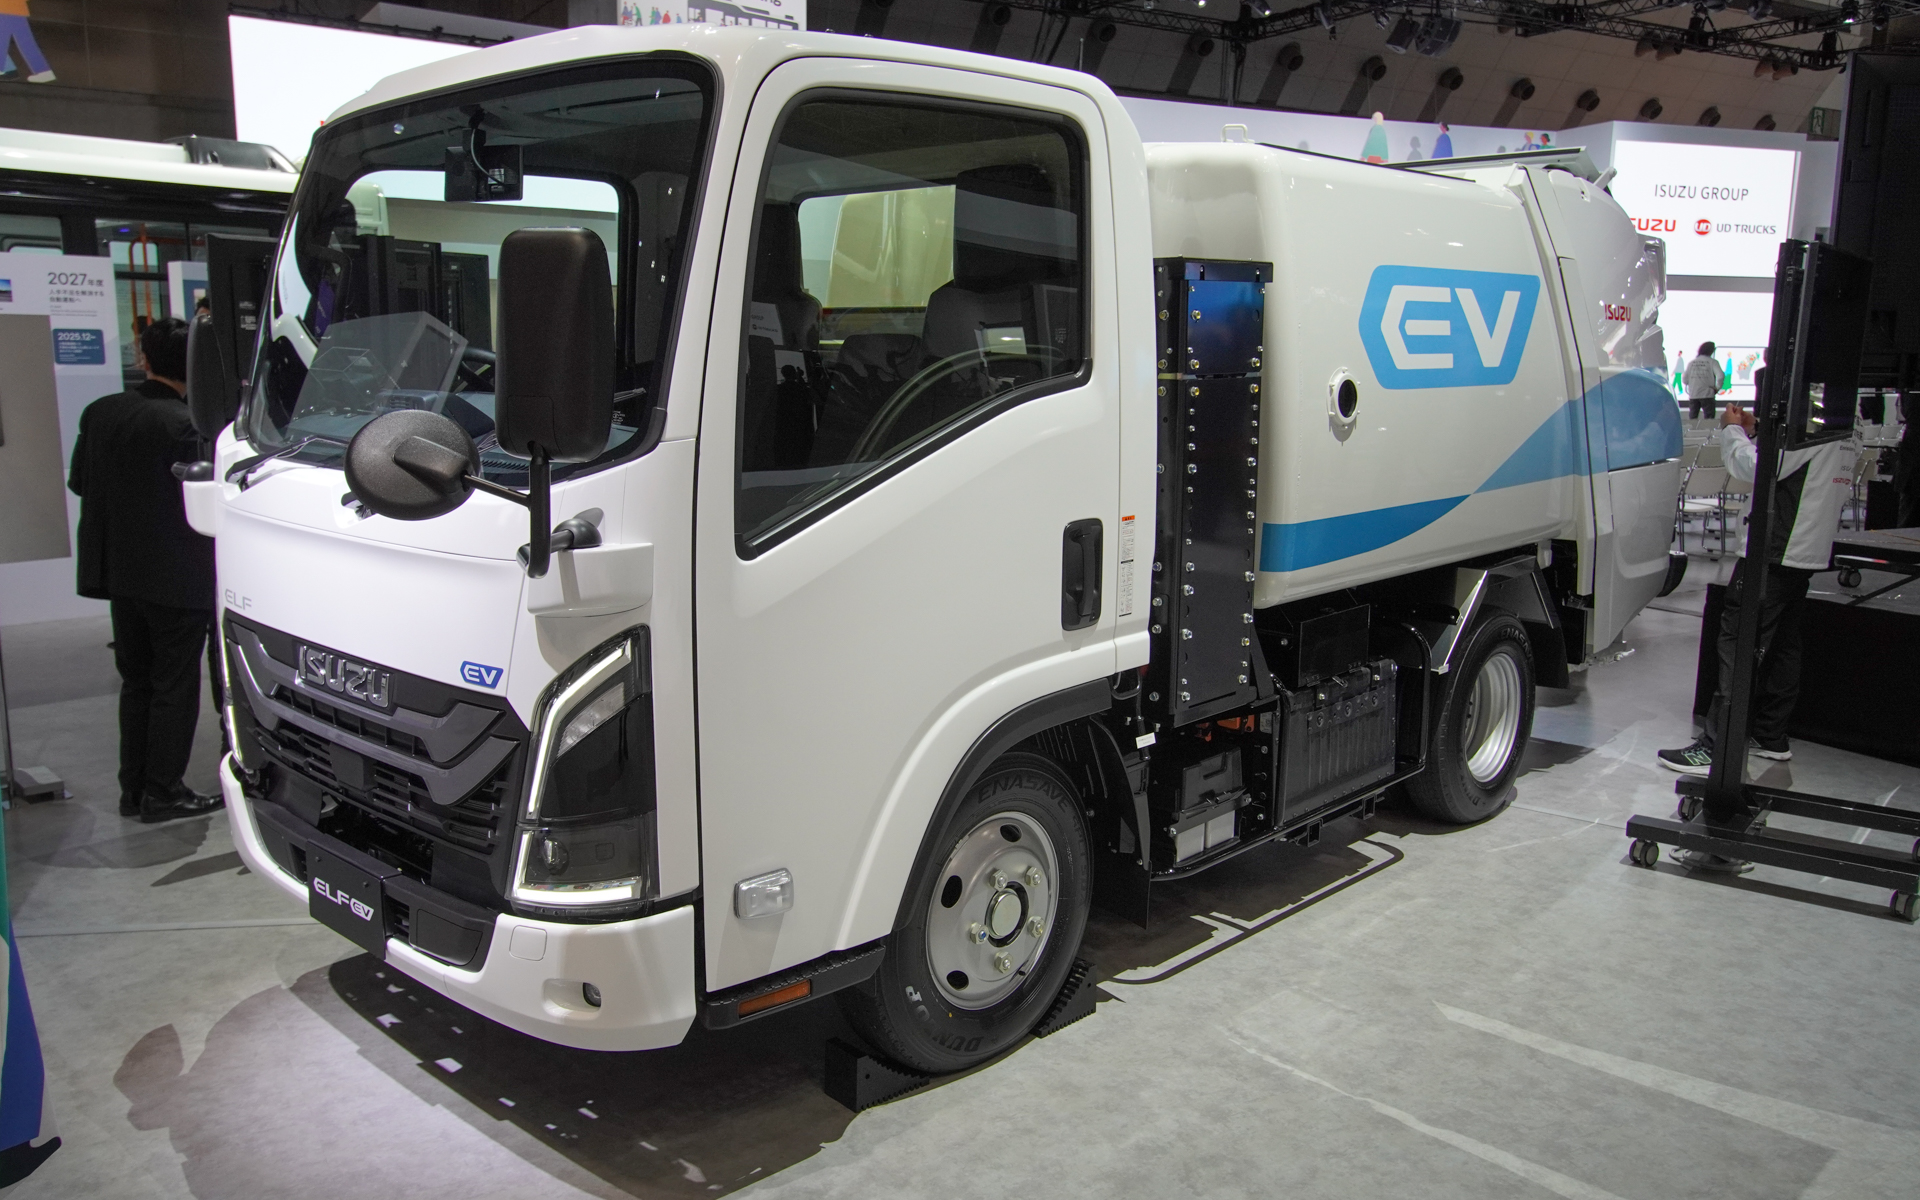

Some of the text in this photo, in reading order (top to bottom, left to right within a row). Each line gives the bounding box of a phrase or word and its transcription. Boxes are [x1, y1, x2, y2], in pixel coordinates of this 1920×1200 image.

[1654, 184, 1749, 201] ISUZU GROUP
[1716, 223, 1776, 234] UD TRUCKS
[1604, 304, 1631, 322] ISUZU
[1381, 285, 1521, 369] EV
[225, 588, 252, 610] ELF
[299, 645, 390, 708] ISUZU
[463, 665, 498, 685] EV
[977, 775, 1070, 813] ENASAVE
[313, 877, 350, 906] ELF
